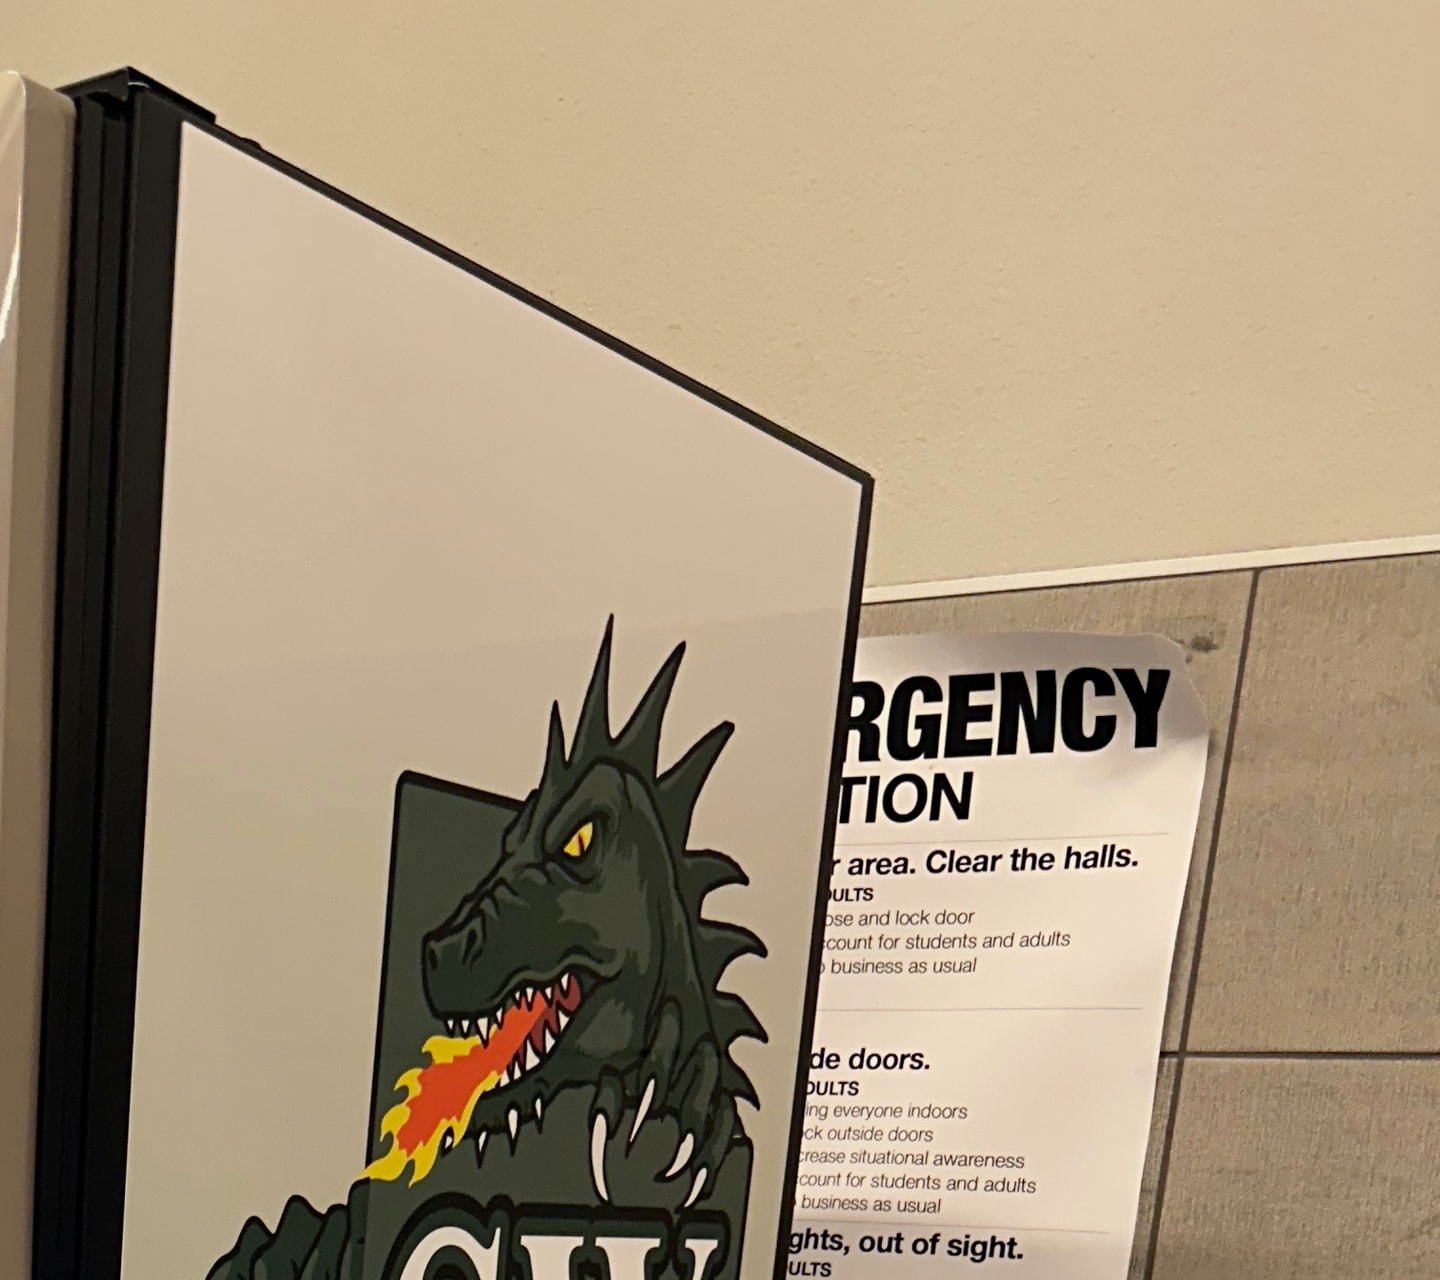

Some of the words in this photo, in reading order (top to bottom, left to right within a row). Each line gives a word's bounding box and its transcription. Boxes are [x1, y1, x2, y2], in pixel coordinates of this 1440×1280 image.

[847, 852, 916, 876] area.
[926, 849, 1002, 874] Clear
[1010, 848, 1055, 872] the
[1063, 844, 1139, 870] halls.
[858, 910, 890, 926] and
[895, 909, 929, 925] lock
[935, 909, 975, 925] door
[878, 933, 900, 949] for
[905, 932, 977, 950] students
[982, 932, 1014, 949] and
[1020, 931, 1071, 948] adults
[831, 958, 903, 975] business
[907, 961, 929, 974] as
[932, 957, 977, 974] usual
[848, 1047, 931, 1070] doors.
[833, 1105, 903, 1121] everyone
[907, 1103, 968, 1120] indoors
[827, 1126, 884, 1142] outside
[888, 1127, 934, 1143] doors
[849, 1150, 929, 1167] situational
[933, 1154, 1025, 1170] awareness
[846, 1172, 867, 1188] for
[870, 1174, 941, 1191] students
[946, 1176, 978, 1192] and
[984, 1177, 1037, 1194] adults
[801, 1195, 868, 1211] business
[872, 1199, 892, 1212] as
[897, 1199, 942, 1214] usual
[859, 1232, 904, 1255] out
[911, 1233, 942, 1255] of
[947, 1235, 1024, 1263] sight.
